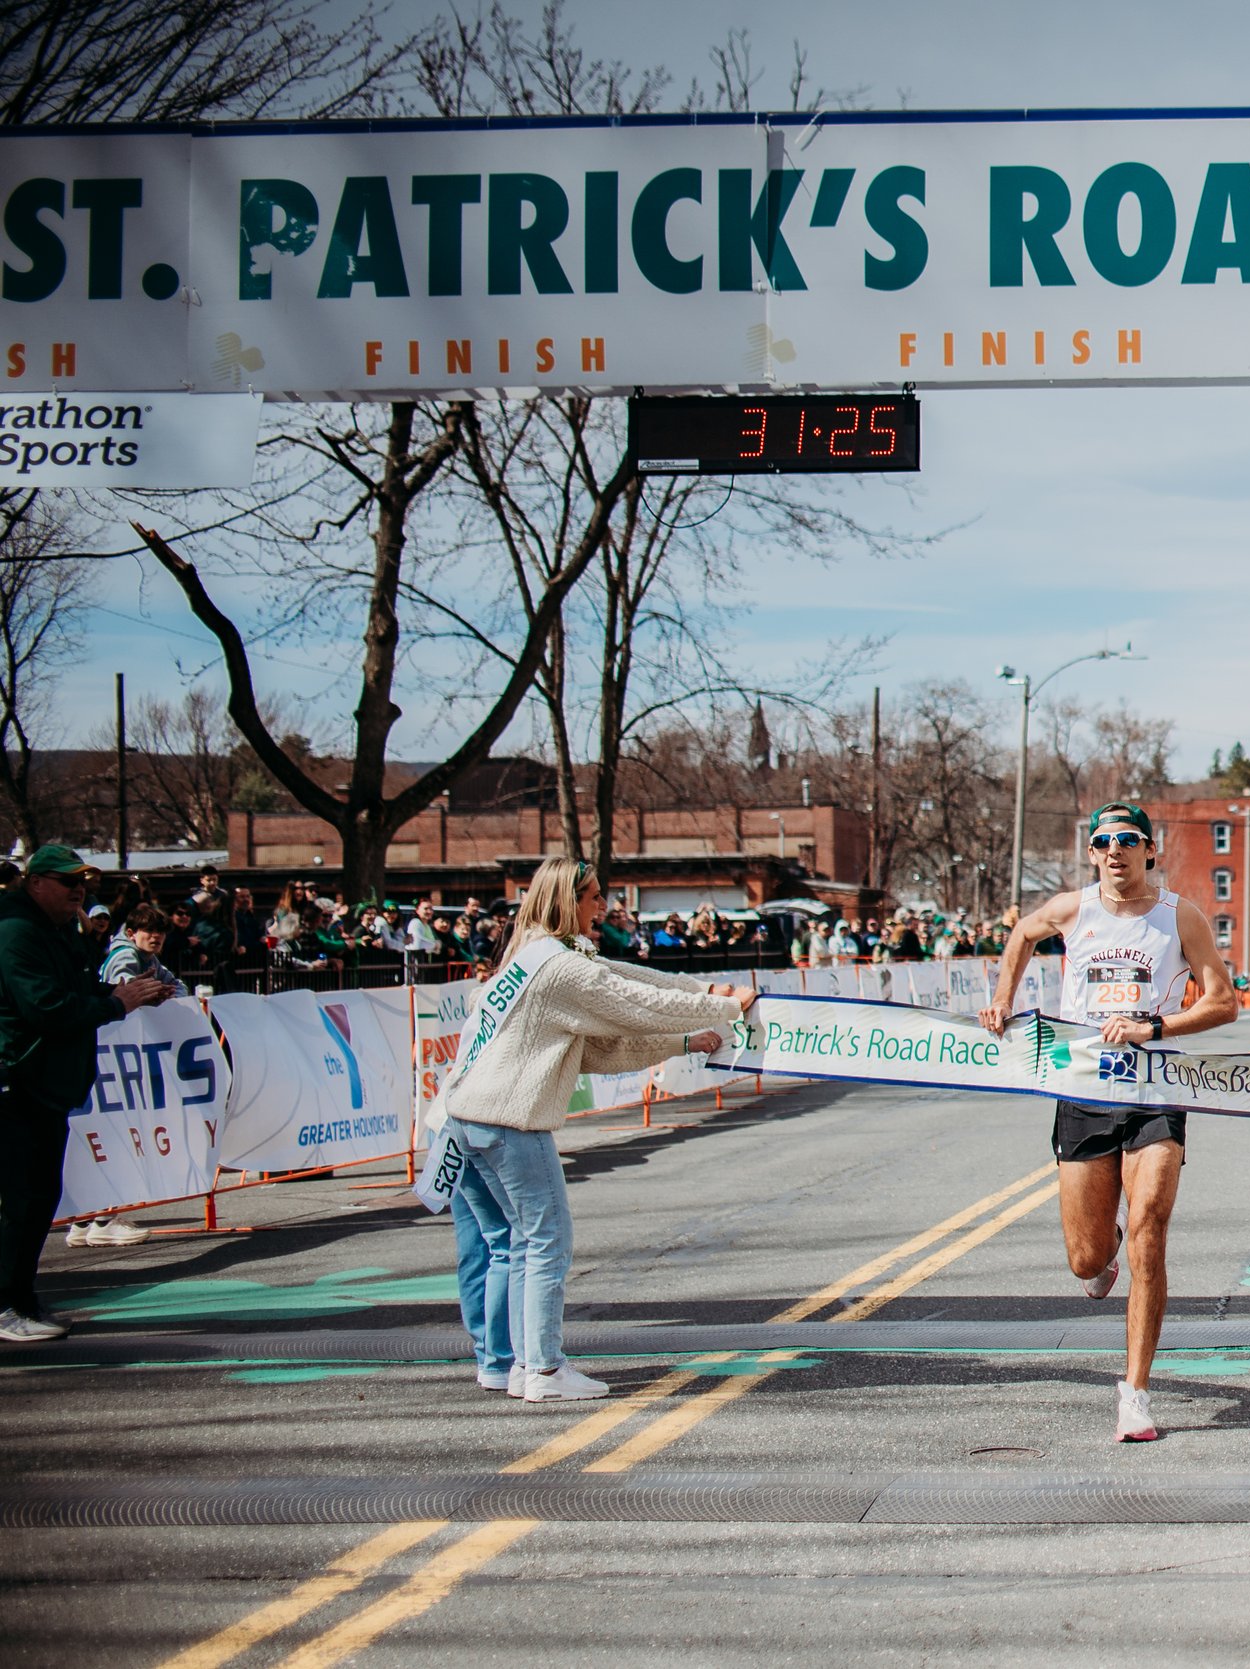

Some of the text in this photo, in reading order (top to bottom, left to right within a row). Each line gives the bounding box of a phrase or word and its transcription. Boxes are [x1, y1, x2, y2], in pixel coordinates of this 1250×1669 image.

[2, 175, 180, 302] ST.
[239, 165, 930, 301] PATRICK'S
[365, 337, 606, 376] FINISH
[900, 329, 1142, 367] FINISH
[0, 433, 139, 475] Sports
[1090, 947, 1154, 970] BUCKNELL
[487, 962, 528, 1012] MISS
[1097, 983, 1141, 1004] 259
[731, 1020, 1000, 1067] St. Patrick's Road Race
[298, 1120, 352, 1146] GREATER
[353, 1115, 385, 1138] HOLYOKE
